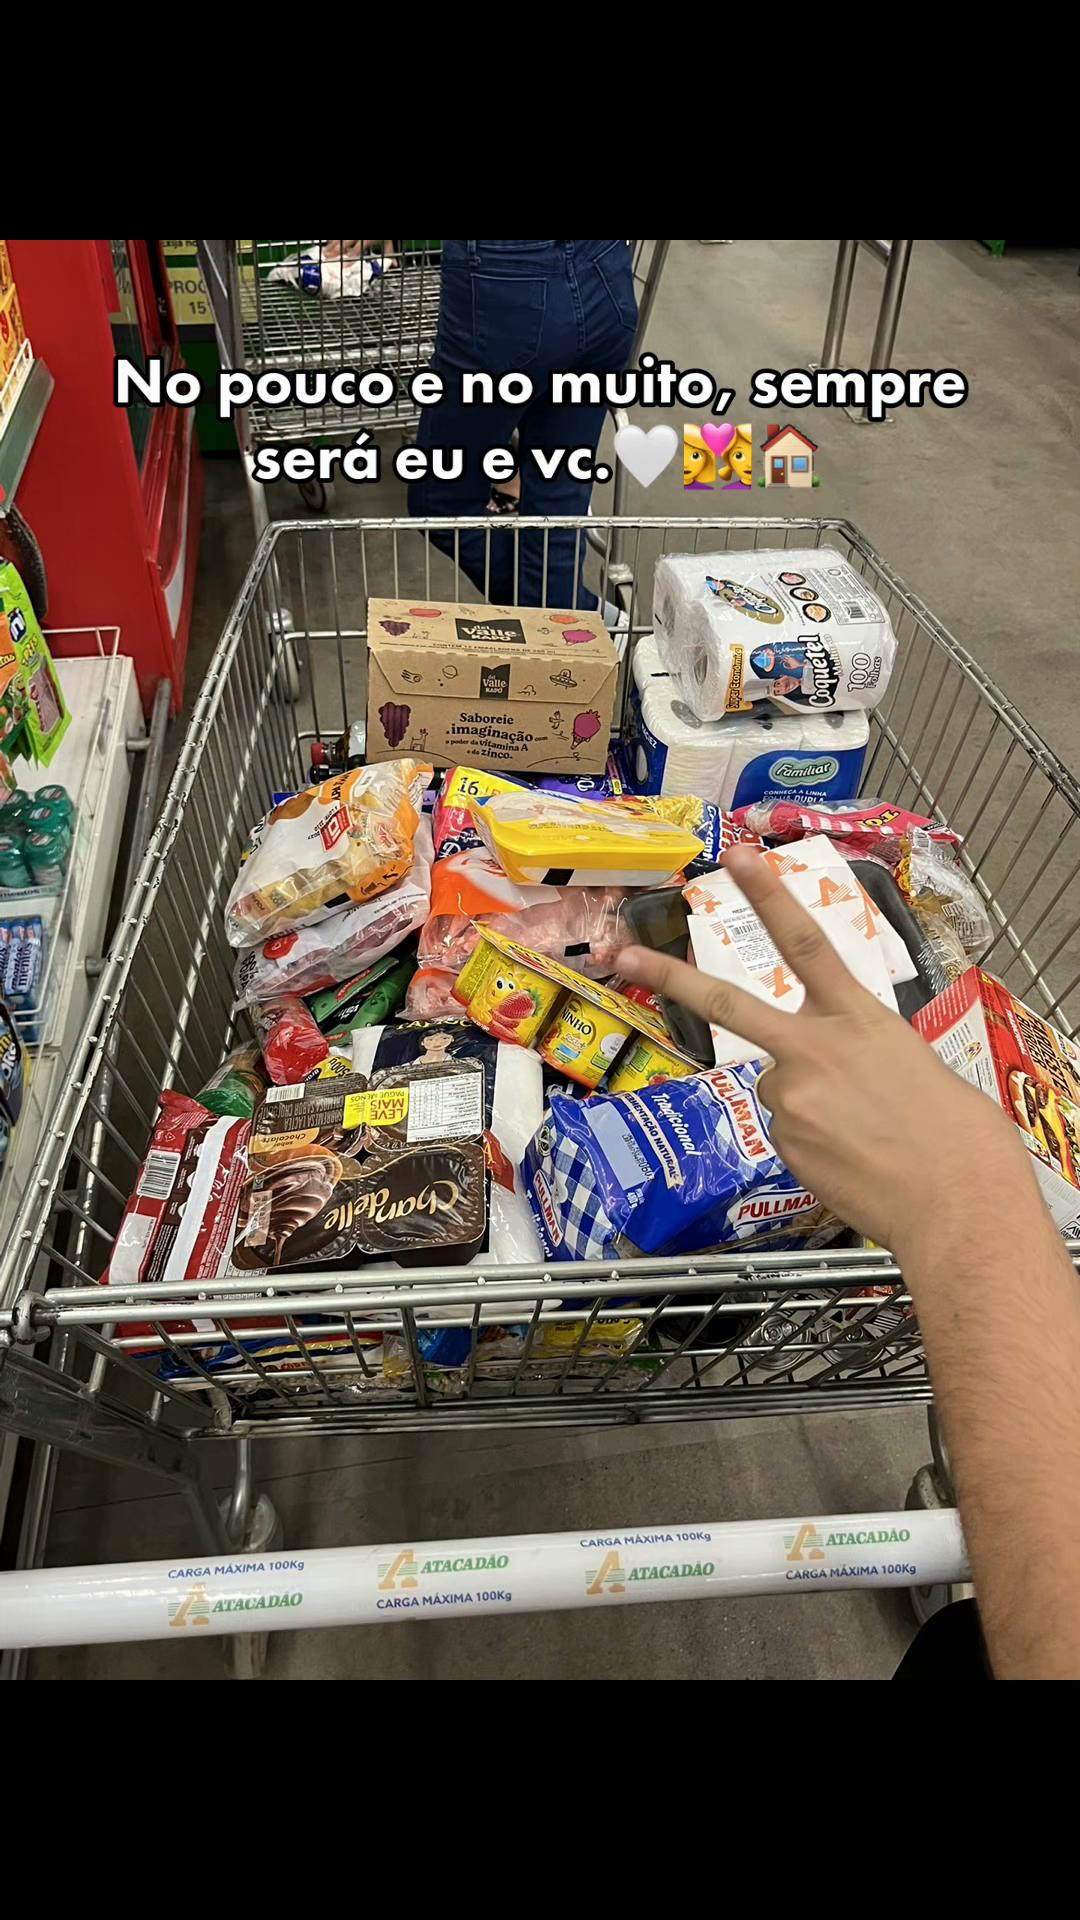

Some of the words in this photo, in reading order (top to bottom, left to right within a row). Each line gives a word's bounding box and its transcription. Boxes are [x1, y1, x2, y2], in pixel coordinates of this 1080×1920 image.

[798, 633, 840, 708] Coquetel
[846, 652, 872, 693] 100
[867, 656, 882, 689] Folhas
[482, 678, 506, 688] Valle
[485, 686, 504, 694] KAPO
[726, 690, 743, 710] Super
[459, 712, 514, 725] Saboreie
[451, 723, 533, 745] imaginação
[479, 738, 520, 752] vitamina
[520, 743, 529, 752] A
[480, 748, 513, 760] zinco.
[776, 761, 832, 777] Familiar
[457, 776, 480, 796] 16
[560, 1007, 592, 1036] NINHO
[1016, 1013, 1047, 1070] BURGER
[1026, 1010, 1073, 1099] FAROESTE
[369, 1099, 405, 1112] MAIS
[369, 1109, 405, 1121] LEVE
[703, 1069, 768, 1158] PULLMAN
[650, 1092, 702, 1157] Tradicional
[653, 1134, 677, 1180] NATURAL
[323, 1179, 459, 1231] Chandelle
[533, 1171, 560, 1242] PULLMAN
[579, 1536, 622, 1548] CARGA
[624, 1533, 674, 1545] MÁXIMA
[675, 1531, 712, 1542] 100Kg
[825, 1528, 911, 1547] ATACADÃO
[167, 1567, 212, 1579] CARGA
[214, 1561, 265, 1575] MÁXIMA
[268, 1559, 305, 1571] 100Kg
[420, 1554, 510, 1574] ATACADÃO
[627, 1560, 716, 1581] ATACADÃO
[784, 1569, 828, 1581] CARGA
[829, 1563, 879, 1577] MÁXIMA
[881, 1562, 917, 1576] 100Kg
[211, 1591, 304, 1613] ATACADÃO
[375, 1596, 420, 1610] CARGA
[421, 1591, 474, 1606] MÁXIMA
[475, 1589, 512, 1602] 100Kg
